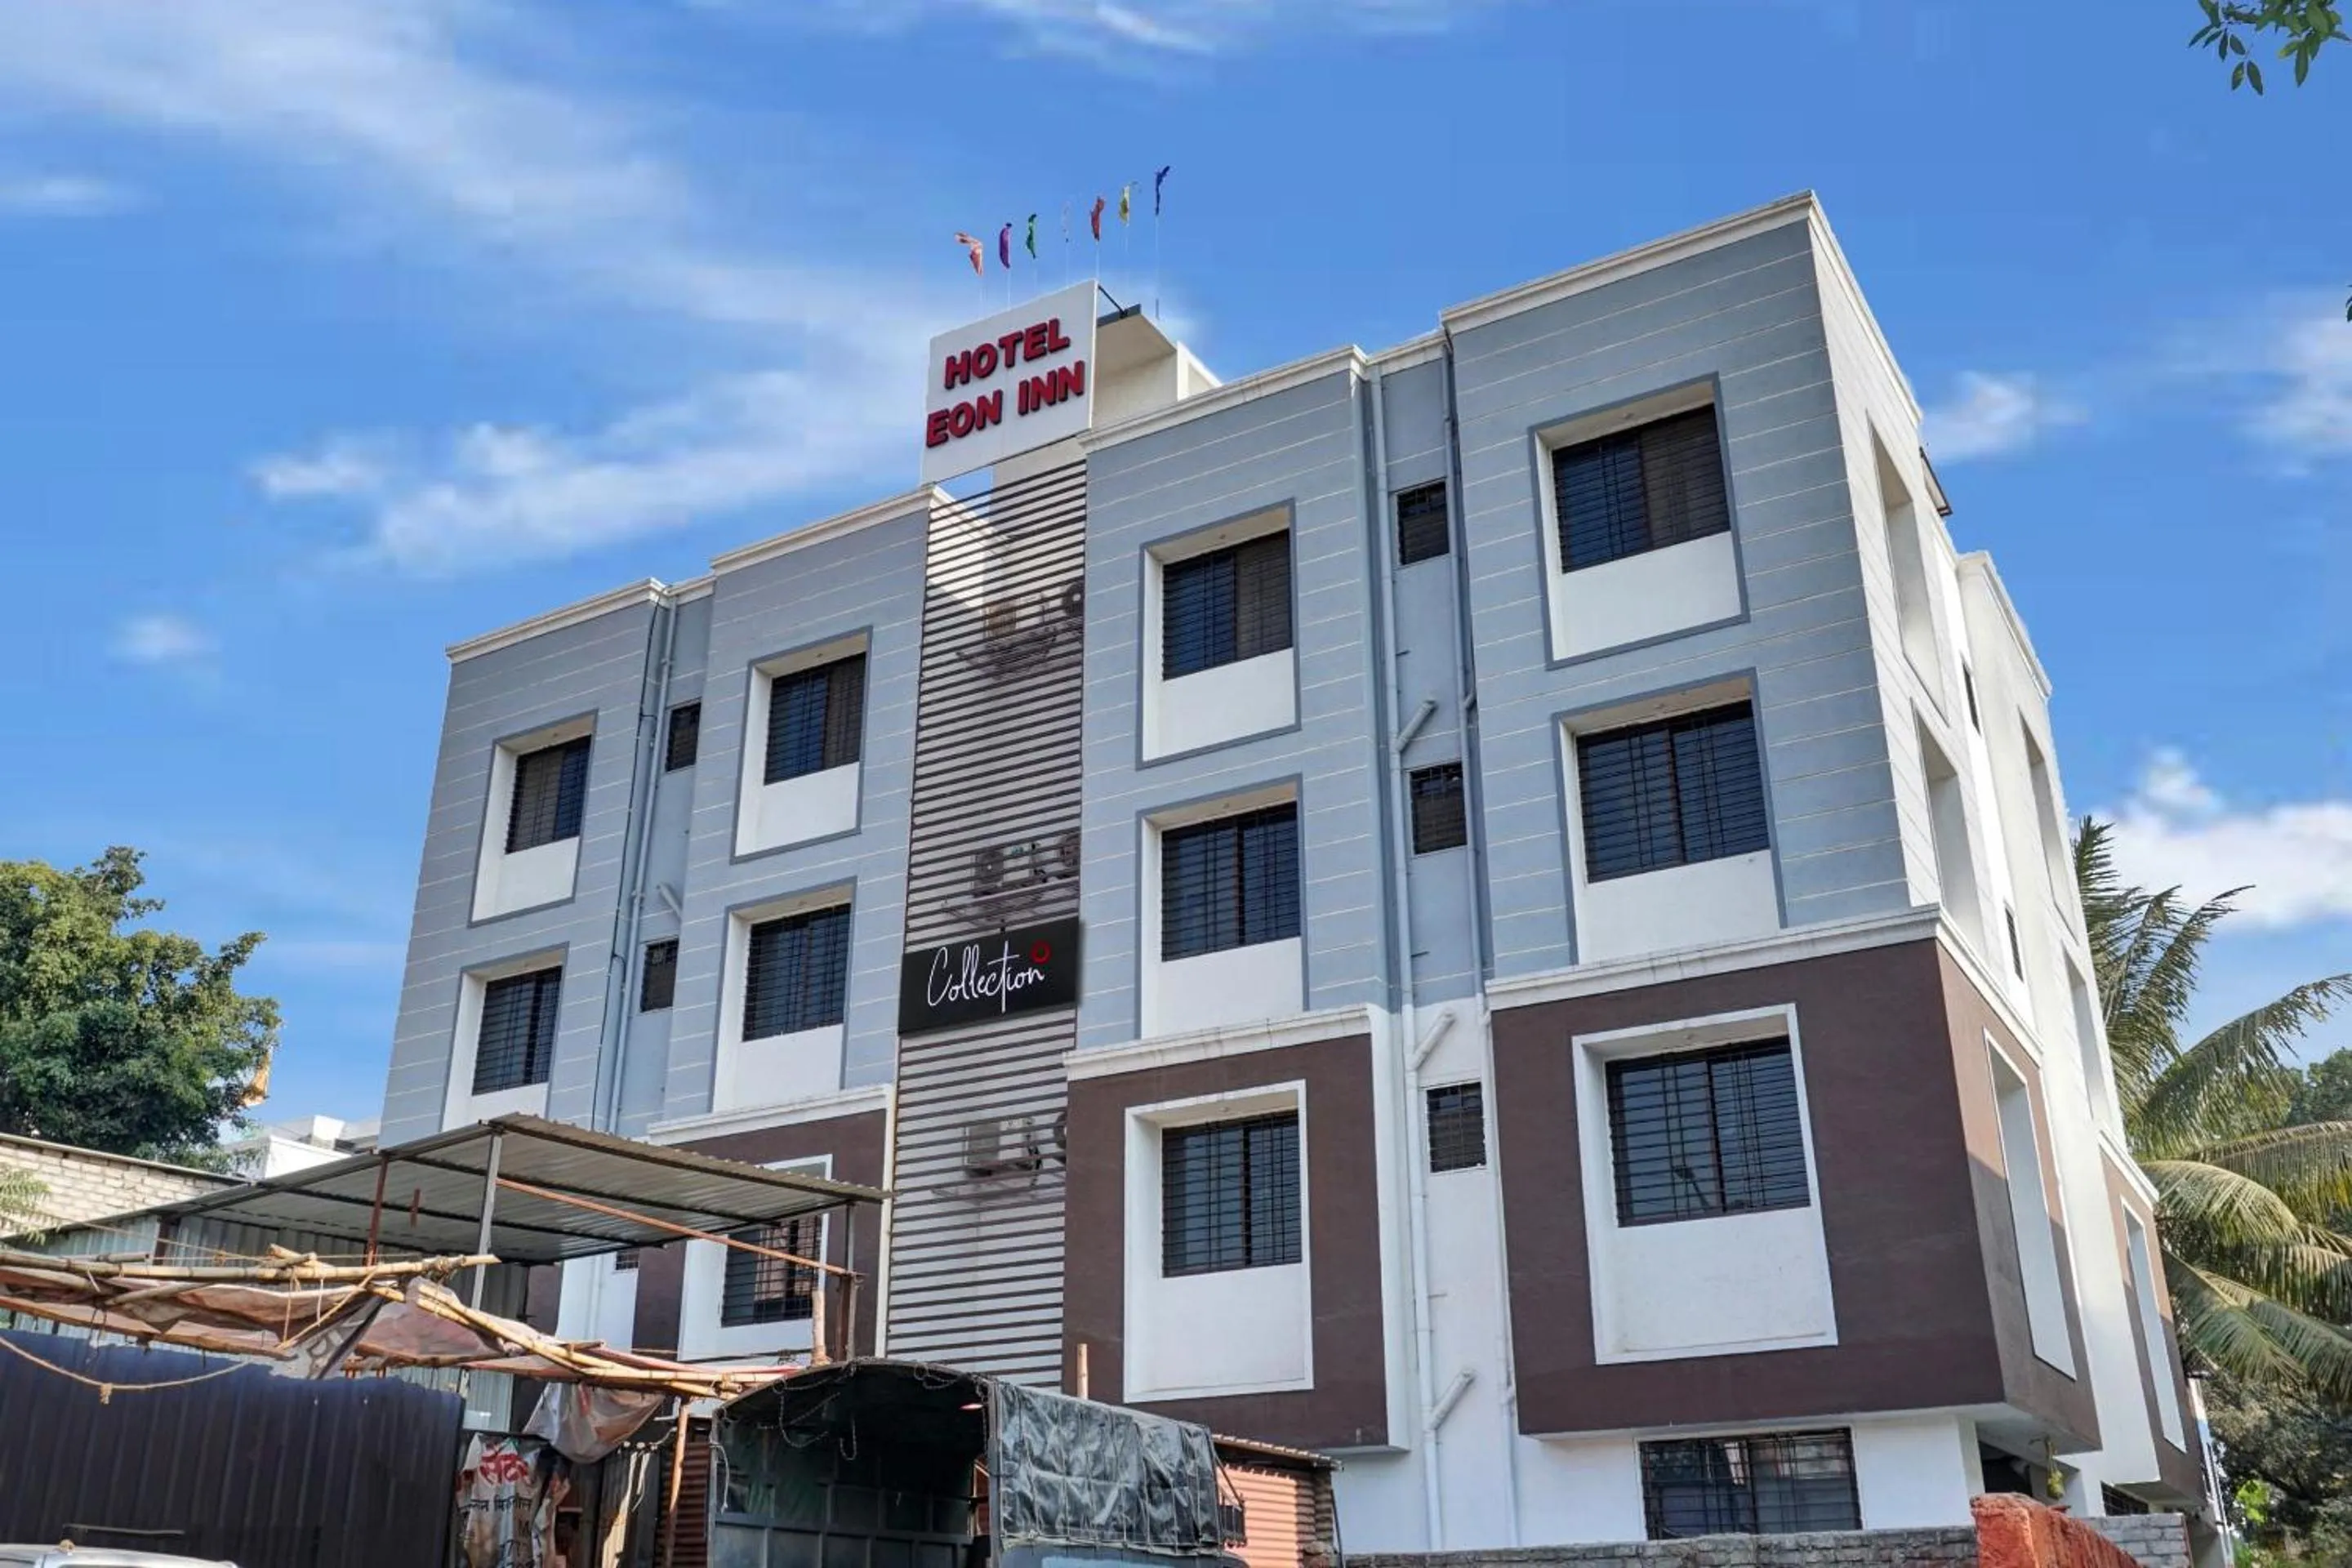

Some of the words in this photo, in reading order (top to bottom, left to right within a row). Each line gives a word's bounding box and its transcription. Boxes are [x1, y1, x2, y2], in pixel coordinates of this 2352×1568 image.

[944, 318, 1071, 390] HOTEL
[926, 389, 1003, 448] EON
[1018, 359, 1085, 416] INN
[928, 940, 1045, 1013] Collection
